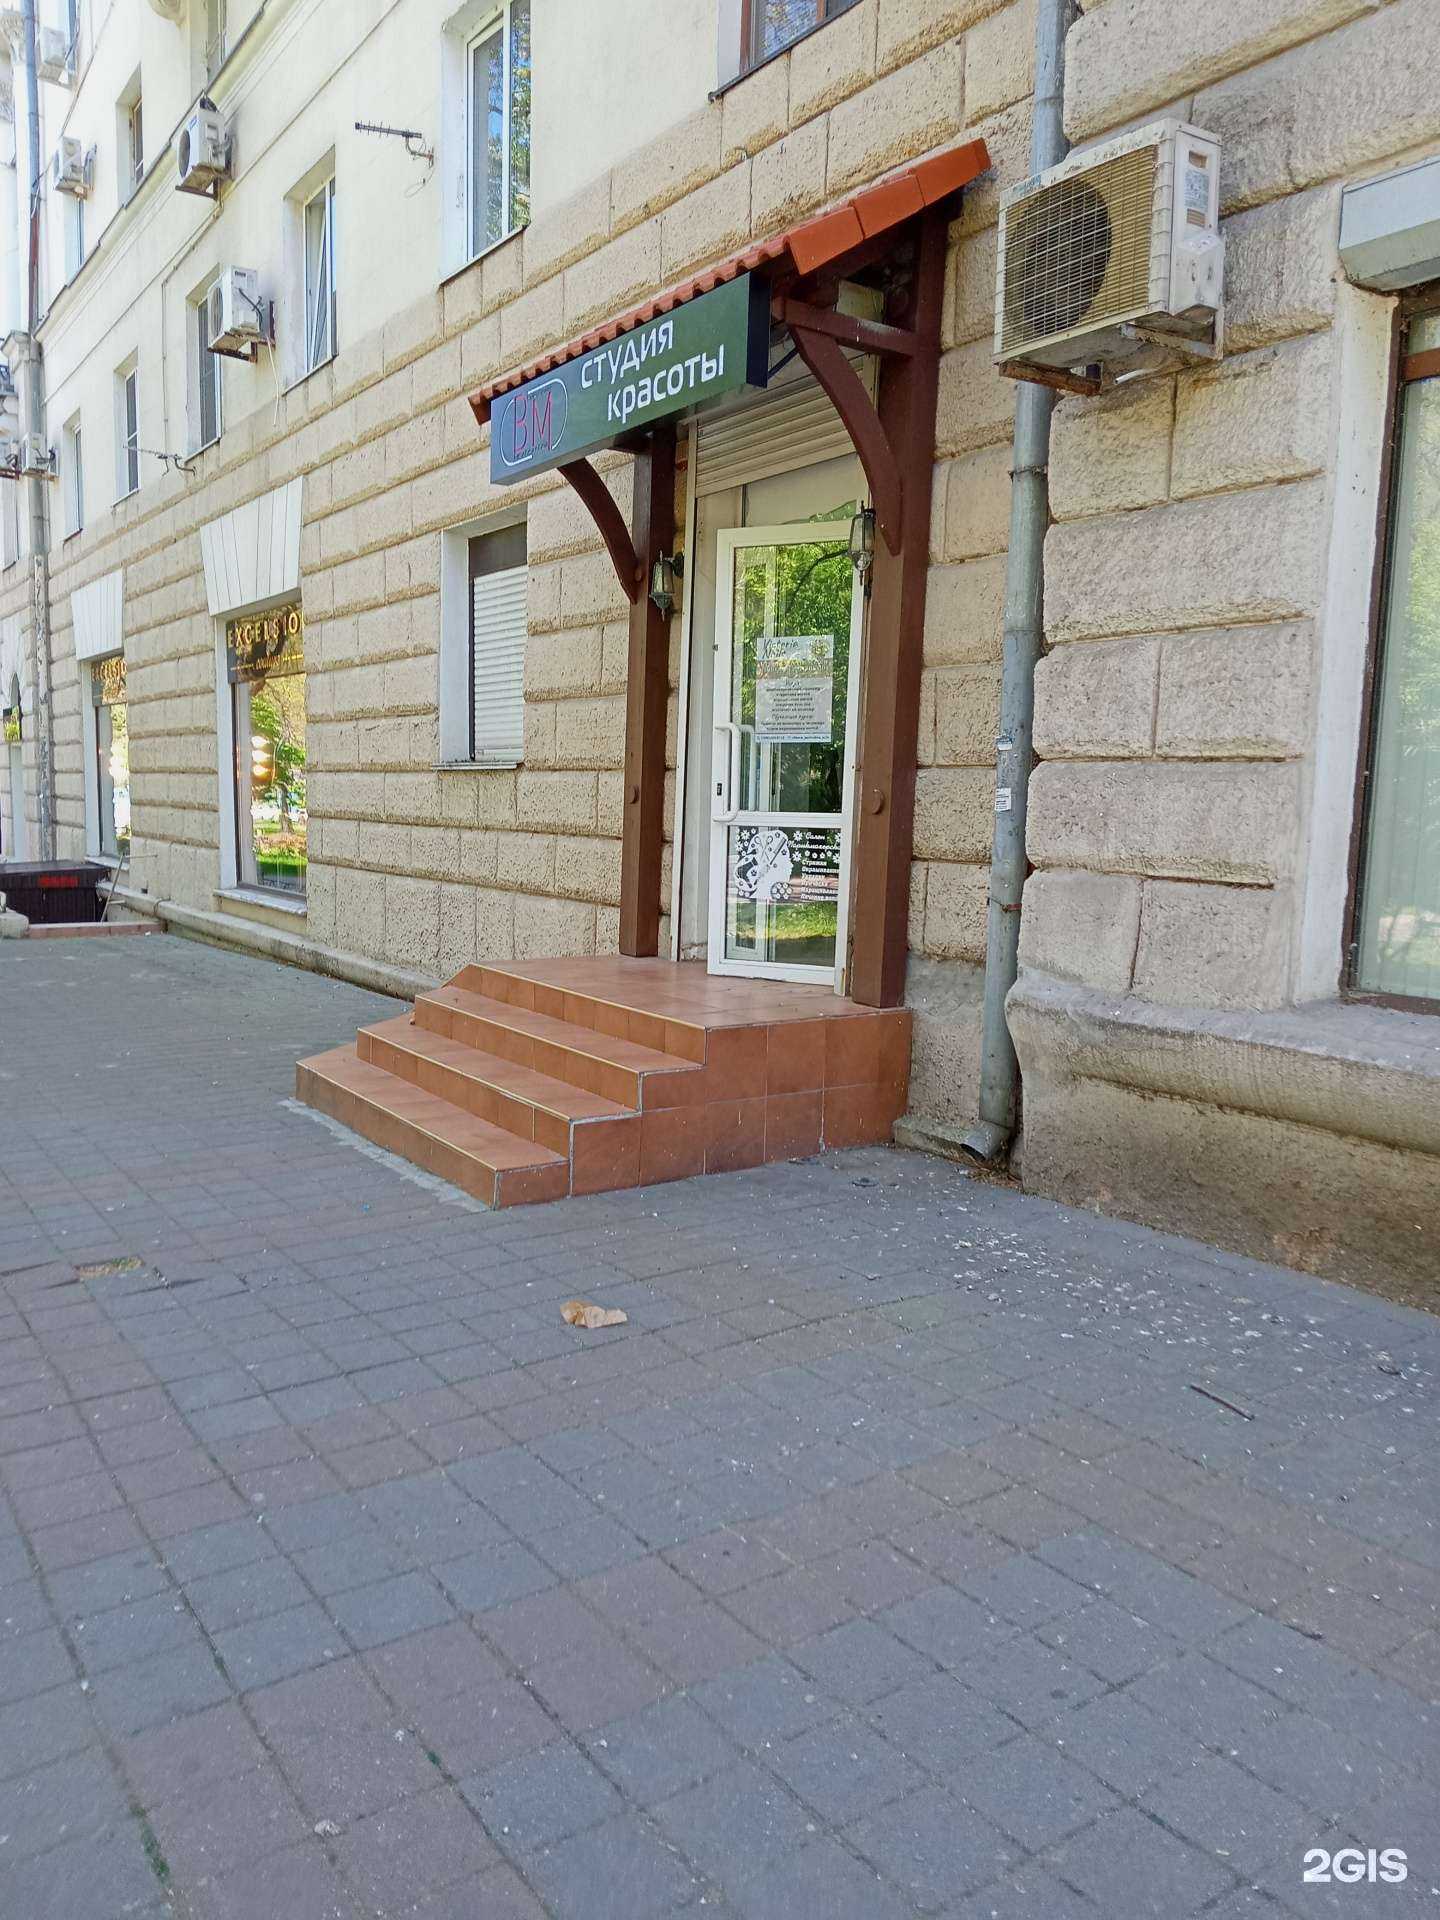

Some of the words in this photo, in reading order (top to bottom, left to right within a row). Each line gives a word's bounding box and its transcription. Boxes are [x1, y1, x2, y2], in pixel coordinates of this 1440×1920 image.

[581, 320, 674, 389] студия
[608, 344, 724, 424] красоты
[227, 612, 304, 649] EXCELSIO
